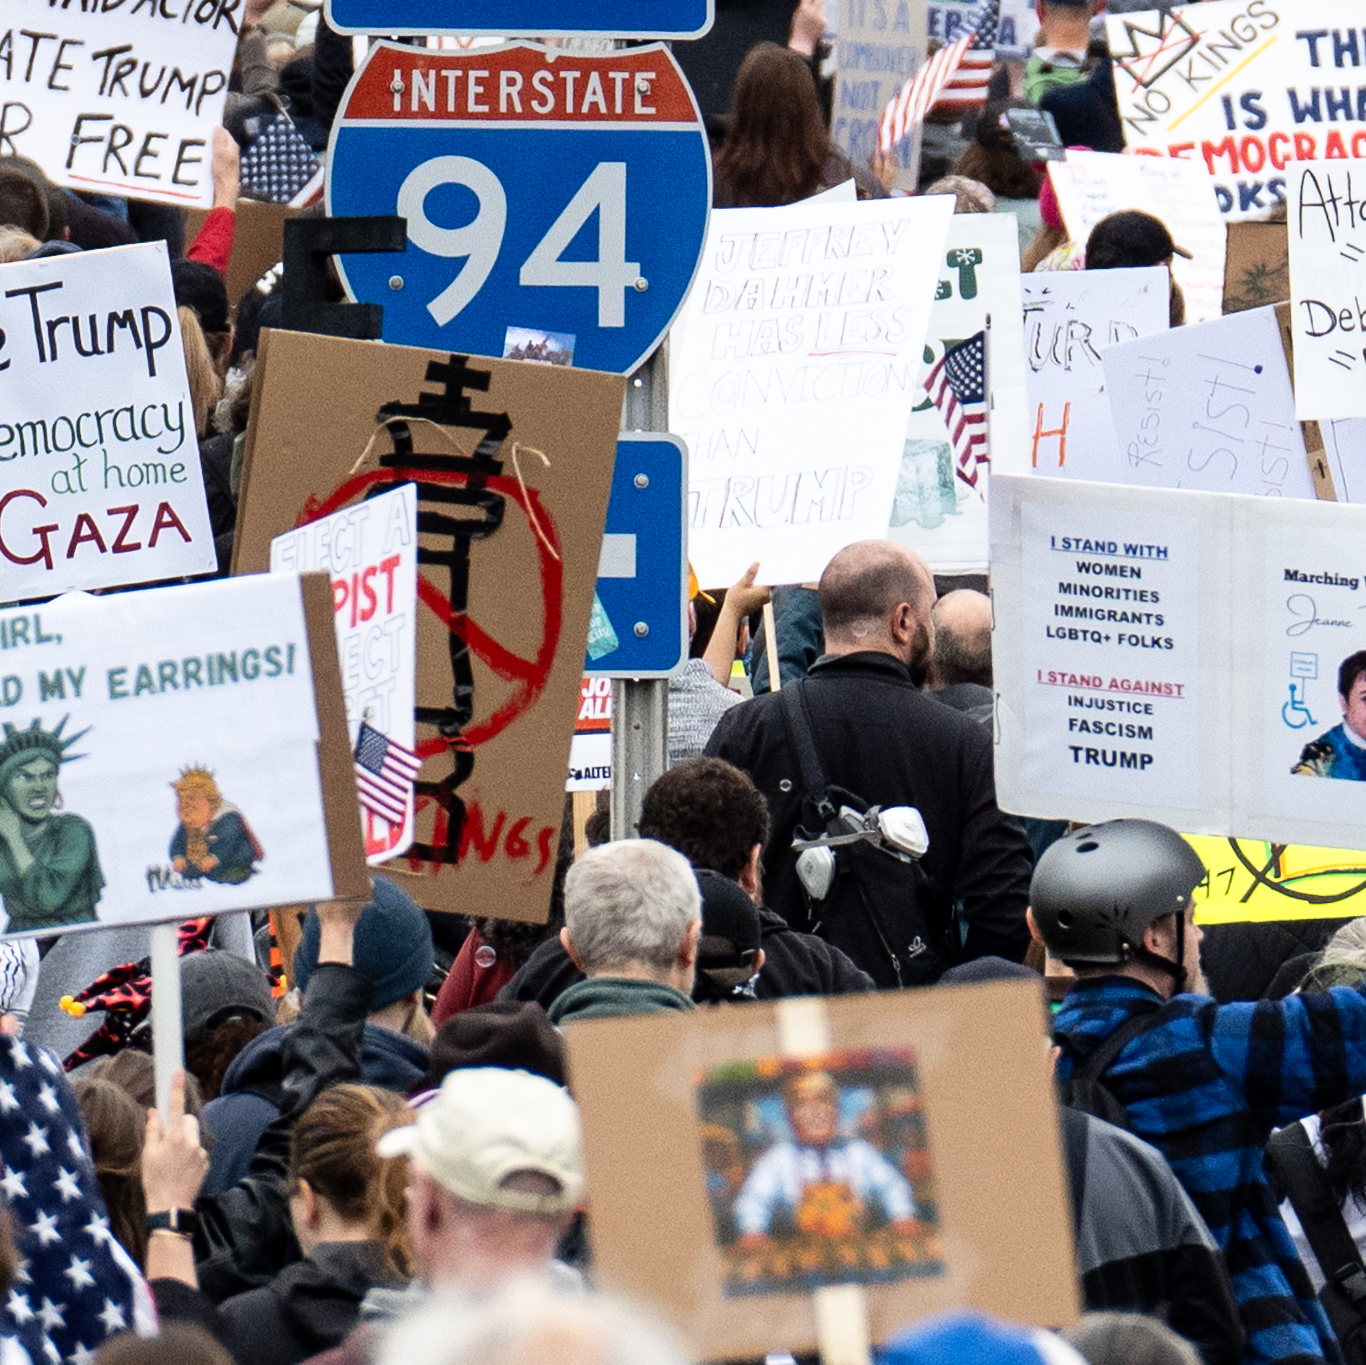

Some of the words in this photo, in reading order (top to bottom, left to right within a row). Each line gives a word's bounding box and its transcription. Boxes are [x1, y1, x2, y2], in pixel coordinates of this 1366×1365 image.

[92, 44, 227, 117] TRUMP
[1122, 87, 1172, 136] NO
[1176, 0, 1280, 93] KINGS
[393, 69, 657, 115] INTERSTATE
[1220, 91, 1268, 132] IS
[65, 112, 207, 187] FREE
[397, 154, 641, 328] 94
[715, 219, 910, 274] JEFFREY
[703, 267, 894, 315] DAHMER
[5, 280, 172, 377] Trump
[711, 316, 805, 361] HAS
[815, 306, 914, 351] LESS
[675, 359, 919, 421] CONVICTIONS
[685, 427, 760, 463] THAN
[51, 453, 89, 494] at
[102, 448, 188, 489] home
[688, 465, 874, 530] TRUMP
[384, 491, 412, 555] A
[1050, 536, 1057, 550] I
[1062, 536, 1118, 556] STAND
[1123, 541, 1169, 560] WITH
[1076, 560, 1142, 580] WOMEN
[1058, 581, 1161, 604] MINORITIES
[1283, 568, 1360, 592] Marching
[1046, 625, 1111, 646] LGBTQ+
[1117, 630, 1174, 651] FOLKS
[1053, 603, 1165, 627] IMMIGRANTS
[39, 665, 86, 703] MY
[106, 642, 298, 700] EARRINGS!
[1036, 669, 1043, 684] I
[1047, 670, 1104, 690] STAND
[1108, 677, 1186, 698] AGAINST
[1068, 694, 1155, 716] INJUSTICE
[1068, 717, 1154, 741] FASCISM
[1068, 745, 1155, 772] TRUMP
